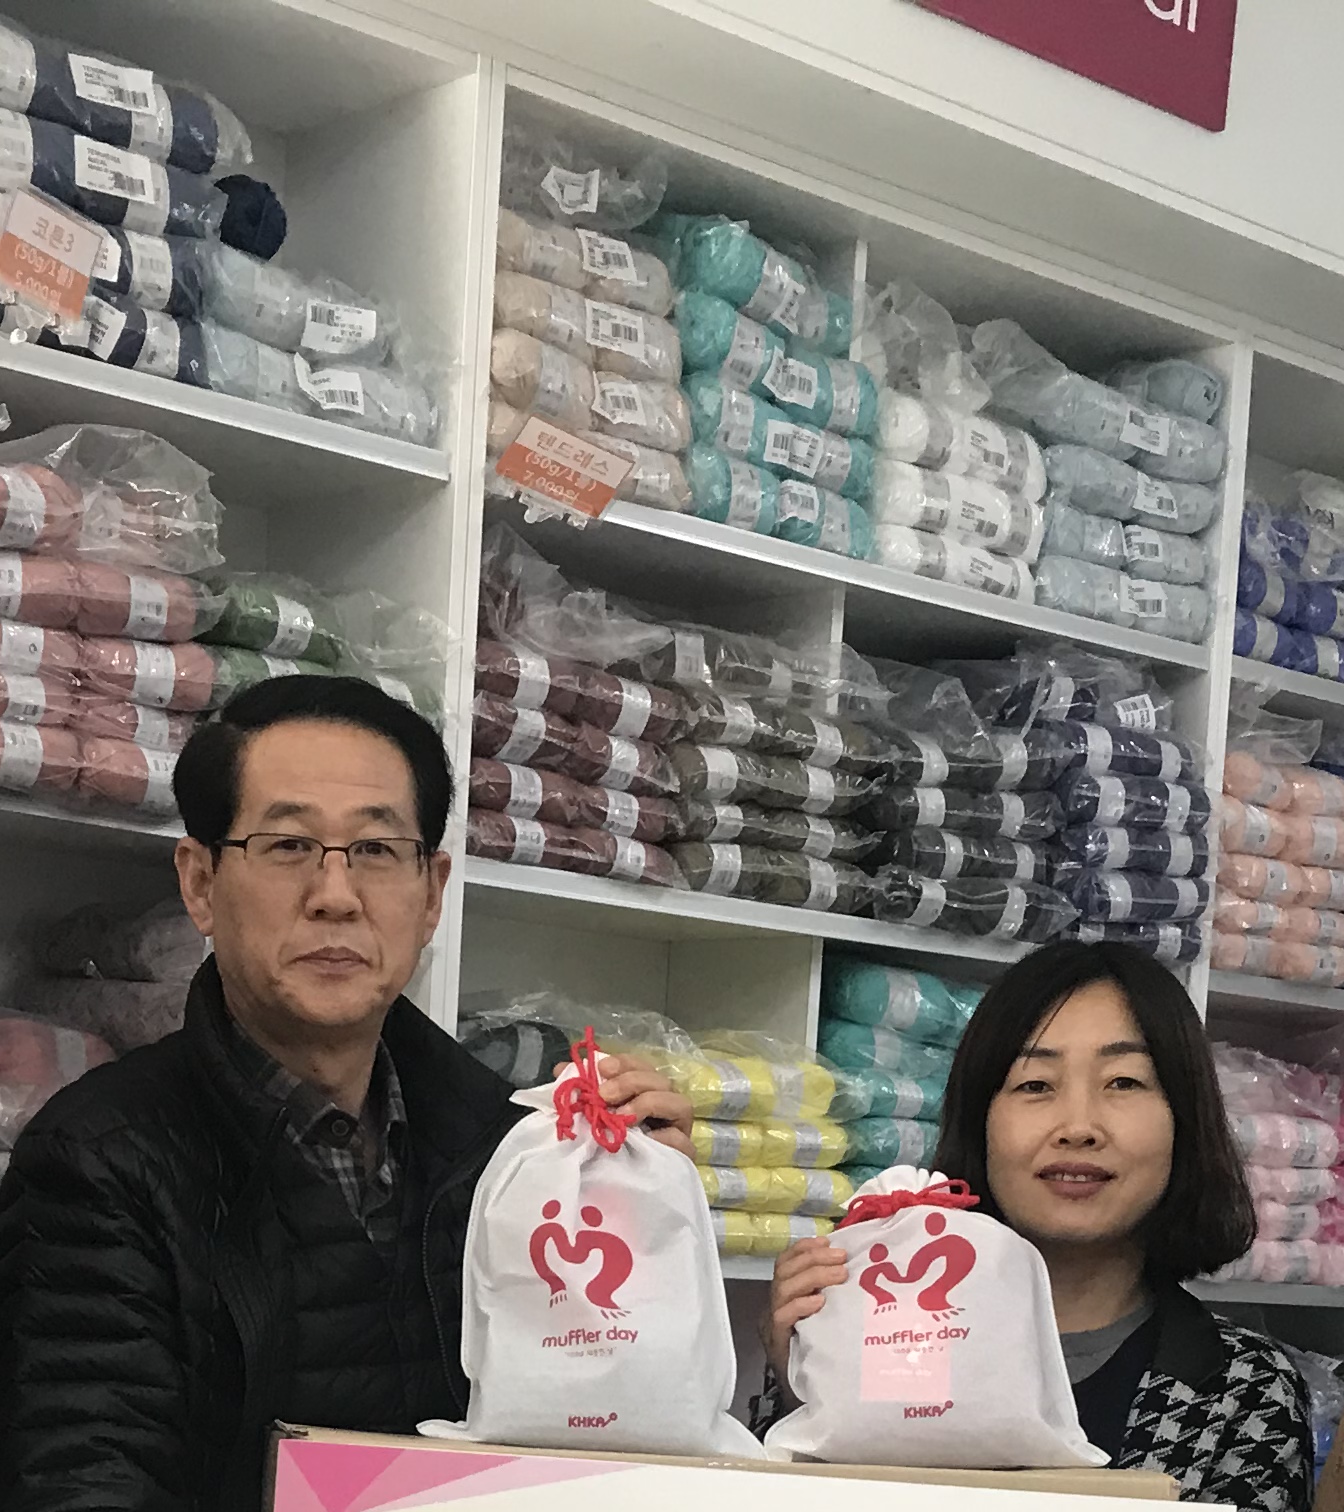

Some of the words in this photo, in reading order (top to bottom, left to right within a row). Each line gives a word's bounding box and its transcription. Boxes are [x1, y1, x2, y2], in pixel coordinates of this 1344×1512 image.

[542, 1328, 602, 1348] muffler
[606, 1325, 639, 1344] day
[864, 1329, 933, 1346] muffler
[936, 1325, 971, 1341] day
